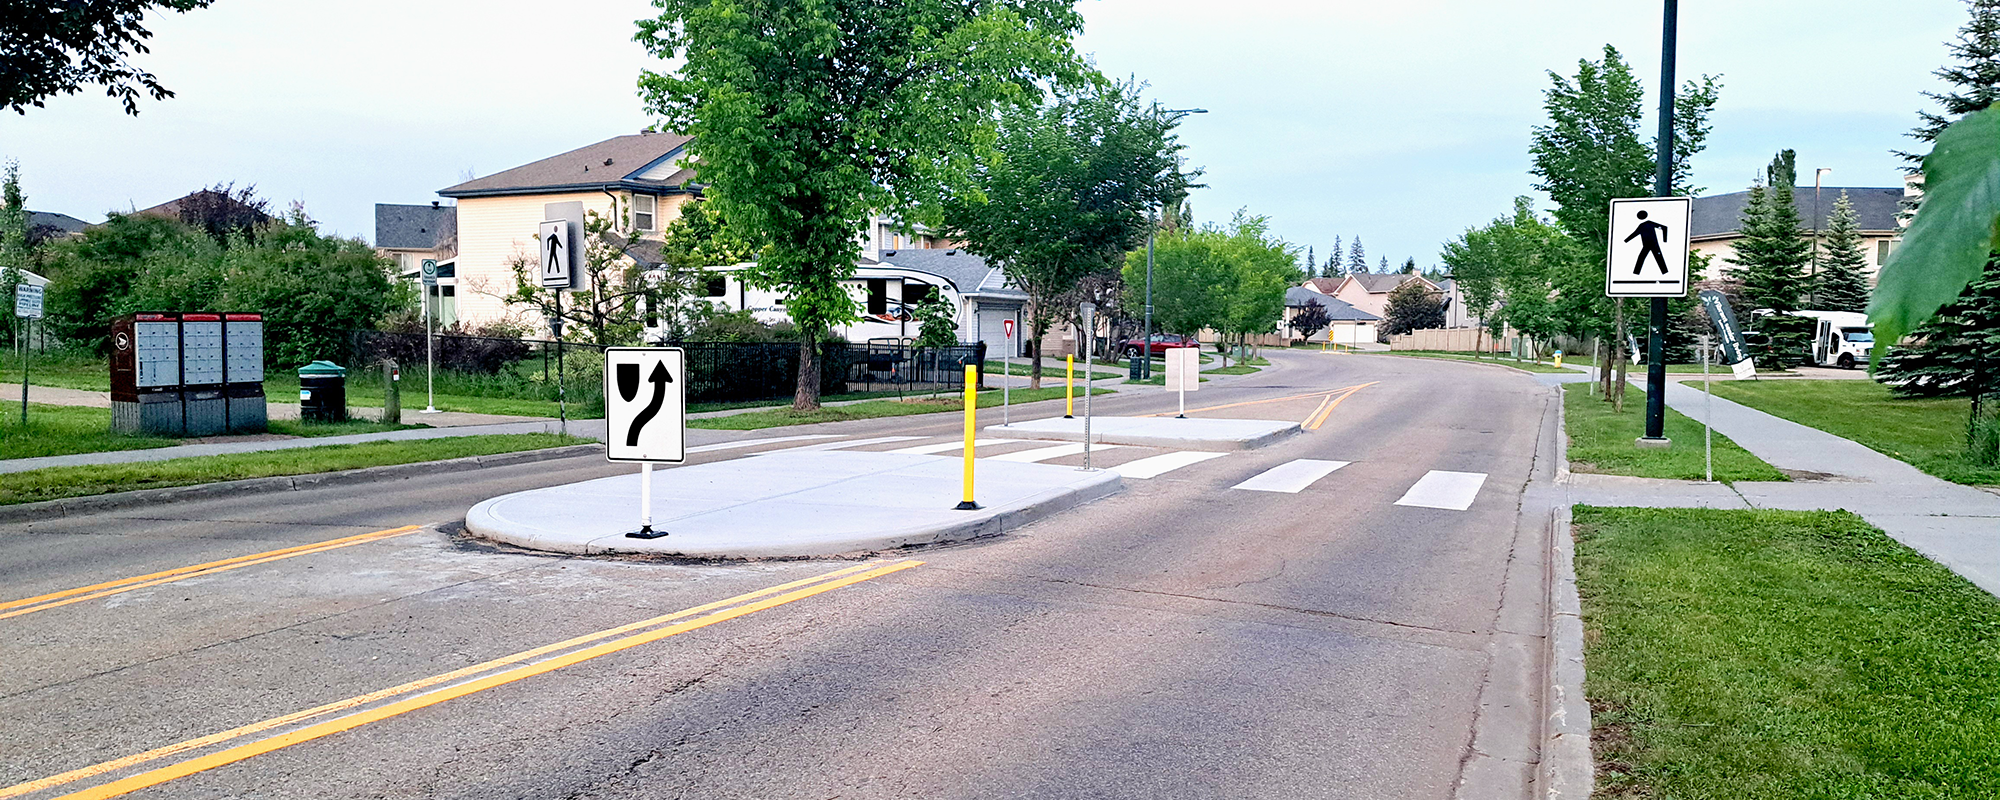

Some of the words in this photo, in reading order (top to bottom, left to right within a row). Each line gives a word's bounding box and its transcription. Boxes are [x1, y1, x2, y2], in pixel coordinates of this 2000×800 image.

[1713, 296, 1728, 322] Vibrant
[1724, 322, 1736, 342] senior
[1732, 342, 1743, 361] living
